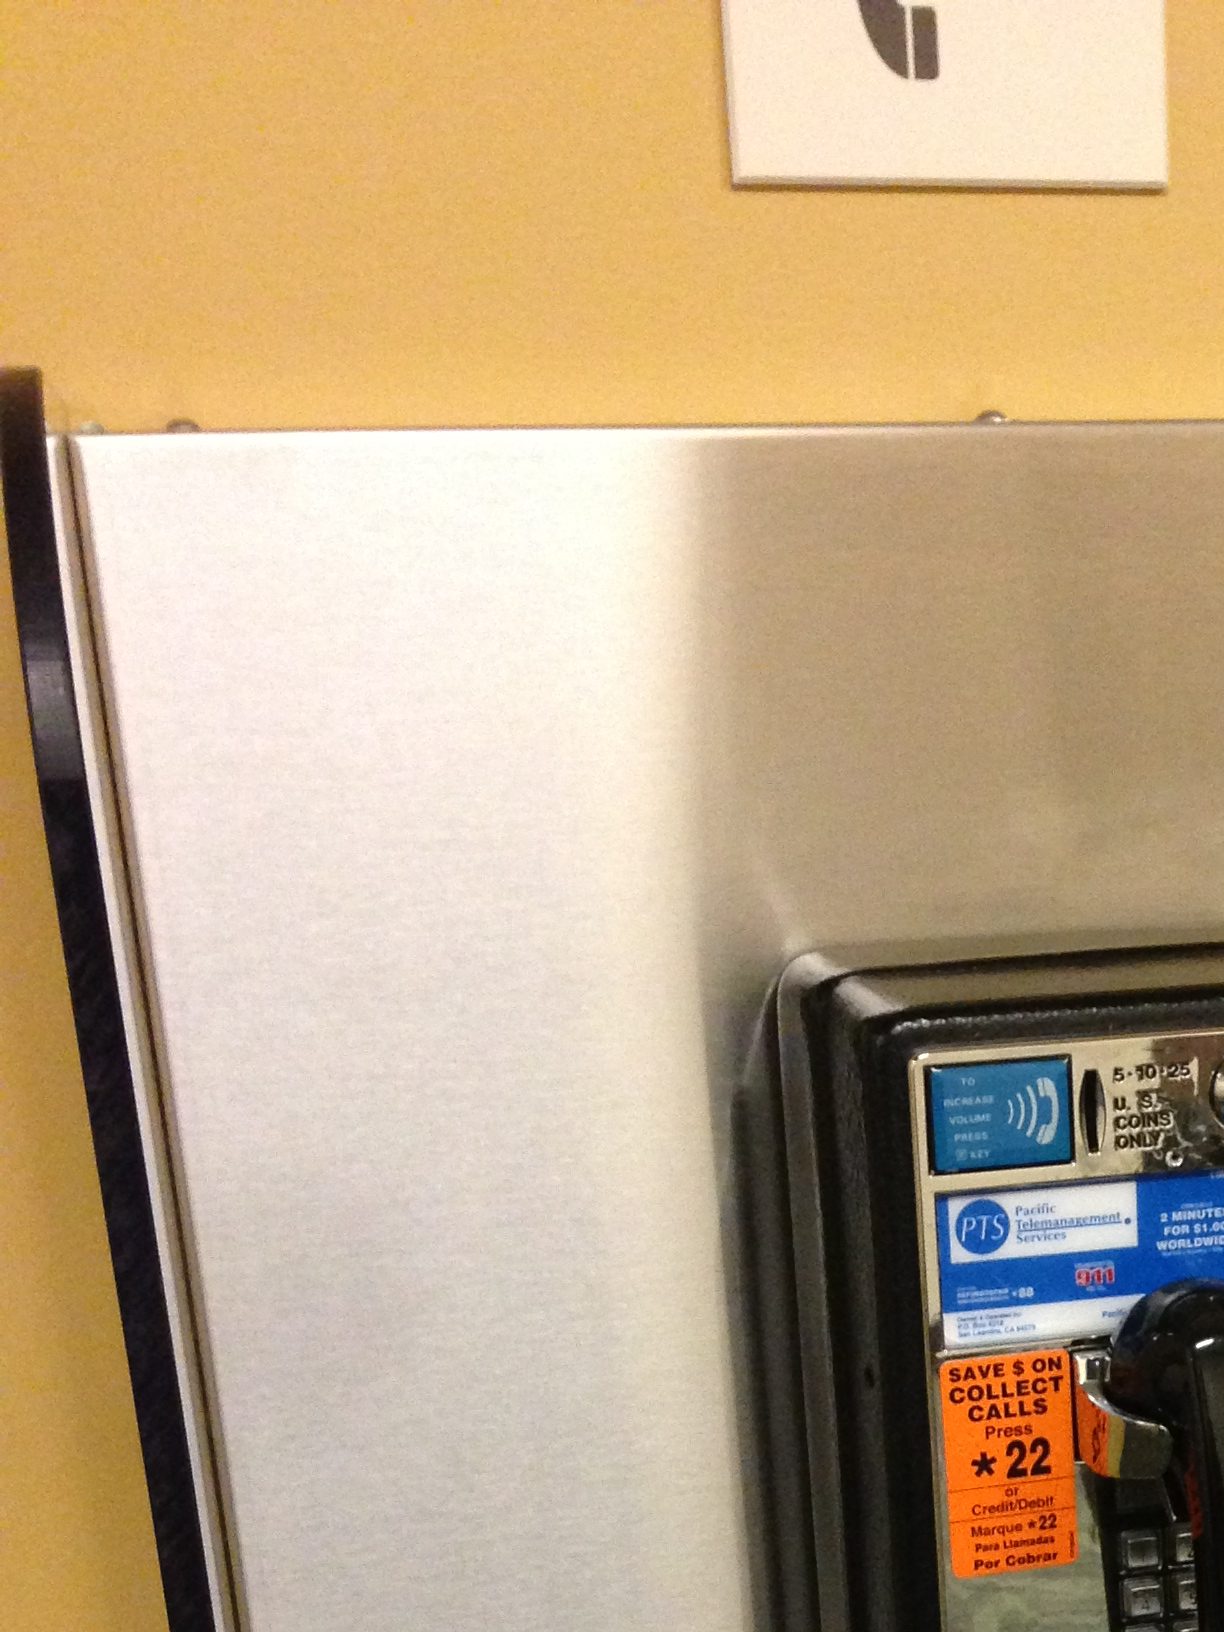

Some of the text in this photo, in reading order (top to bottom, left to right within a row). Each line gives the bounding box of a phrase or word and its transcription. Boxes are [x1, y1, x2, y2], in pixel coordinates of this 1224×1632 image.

[949, 1114, 991, 1125] VOLUME
[1113, 1112, 1172, 1129] COINS
[954, 1132, 988, 1142] PRESS
[1114, 1131, 1162, 1150] ONLY
[1015, 1203, 1056, 1216] Pacific
[1160, 1212, 1168, 1222] 2
[961, 1213, 1006, 1242] PTS
[1015, 1212, 1121, 1230] Telemanagement
[1016, 1230, 1067, 1244] Services
[1164, 1224, 1190, 1236] FOR
[1076, 1267, 1115, 1287] 911
[949, 1356, 1062, 1382] SAVE $ ON
[949, 1375, 1064, 1404] COLLECT
[968, 1398, 1048, 1422] CALLS
[985, 1424, 1033, 1440] Press
[1005, 1487, 1019, 1497] or
[971, 1496, 1054, 1516] Credit/Debit
[971, 1522, 1023, 1537] Marque
[975, 1543, 1000, 1553] Para
[1003, 1535, 1055, 1550] Llamadas
[974, 1552, 1058, 1570] Por Cobrar
